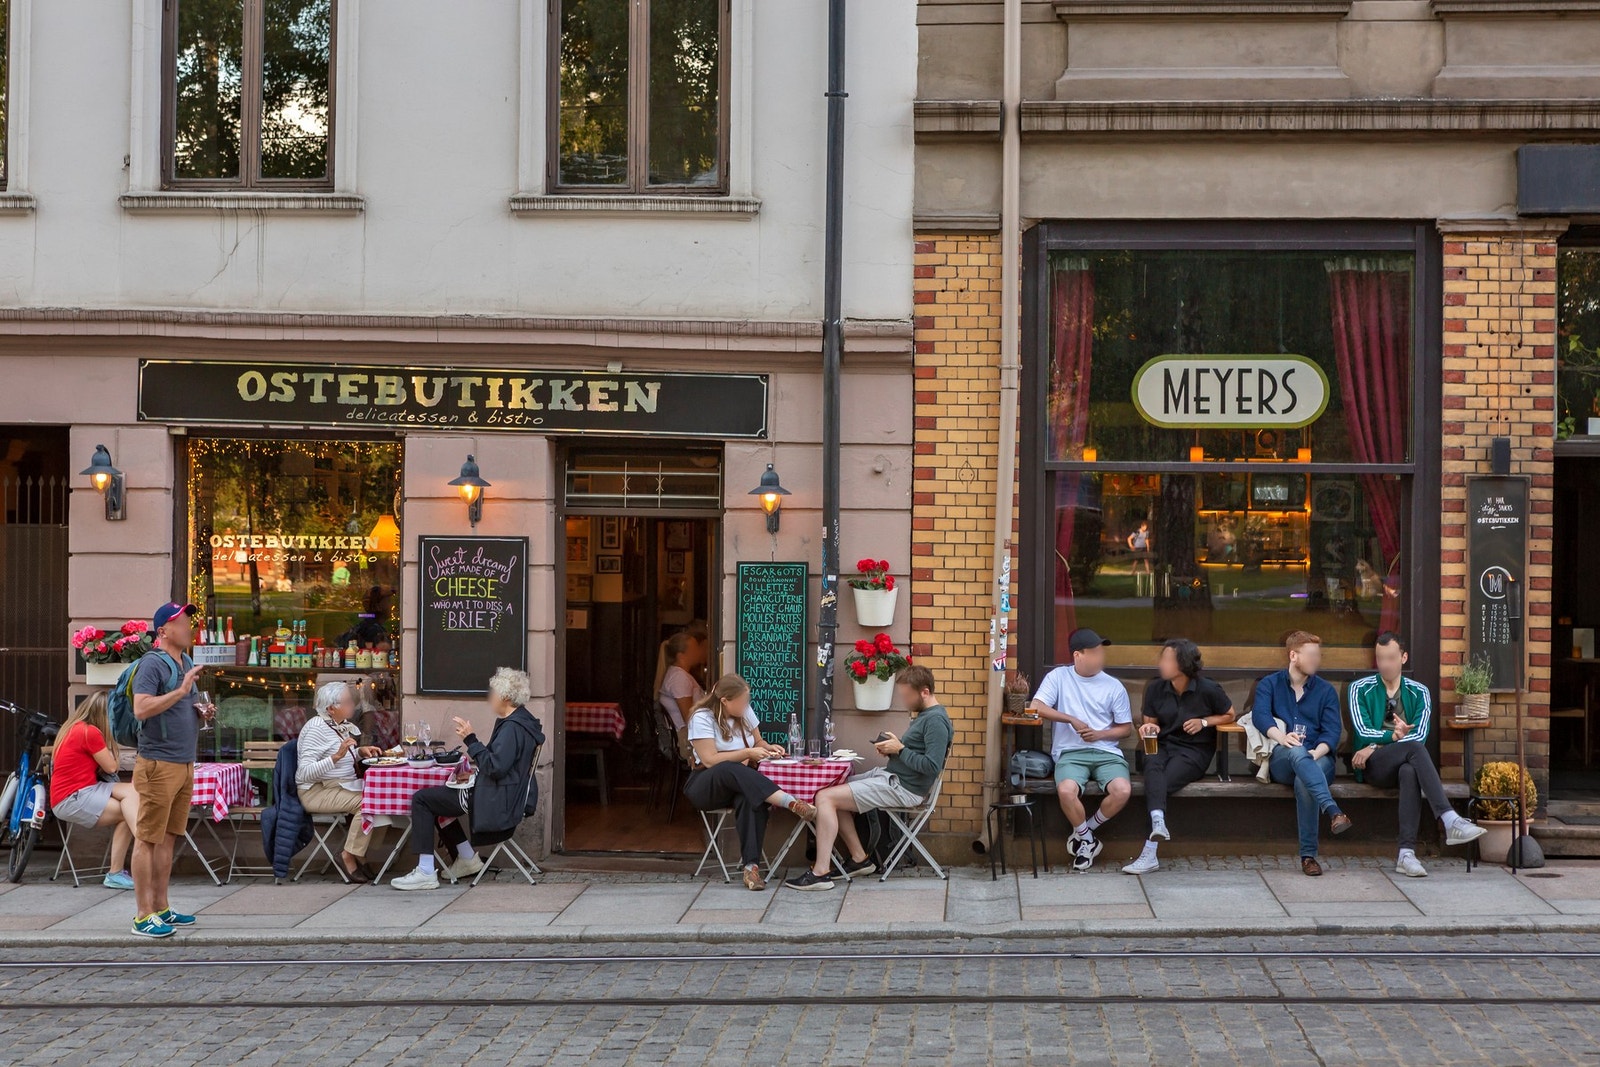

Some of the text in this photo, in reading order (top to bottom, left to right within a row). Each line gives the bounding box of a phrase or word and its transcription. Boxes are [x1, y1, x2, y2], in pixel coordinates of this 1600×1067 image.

[236, 370, 661, 413] OSTEBUTIKKEN
[1163, 368, 1298, 415] MEYERS
[346, 407, 544, 425] delicatessen & bistro
[209, 534, 379, 550] OSTEBUTIKKEN
[313, 551, 323, 562] &
[329, 552, 378, 563] bistro
[428, 545, 467, 580] Sweet
[440, 565, 496, 578] ARE MADE OF
[743, 566, 802, 576] ESCARGOTS
[435, 577, 499, 599] CHEESE
[743, 583, 794, 592] RILLETTES
[743, 594, 803, 604] CHARCUTERIE
[451, 601, 464, 609] AM
[465, 600, 470, 609] I
[472, 600, 483, 610] TO
[485, 601, 503, 611] DISS
[505, 603, 513, 615] A
[778, 603, 803, 614] CHAUD
[448, 611, 498, 630] BRIE?
[743, 613, 802, 624] MOULES FRITES
[742, 622, 800, 633] BOUILLABAISSE
[747, 632, 793, 642] BRANDADE
[742, 641, 800, 652] CASSOULET
[743, 652, 798, 663] PARMENTIER
[749, 689, 799, 700] HAMPAGNE
[749, 700, 795, 712] ONS VINS
